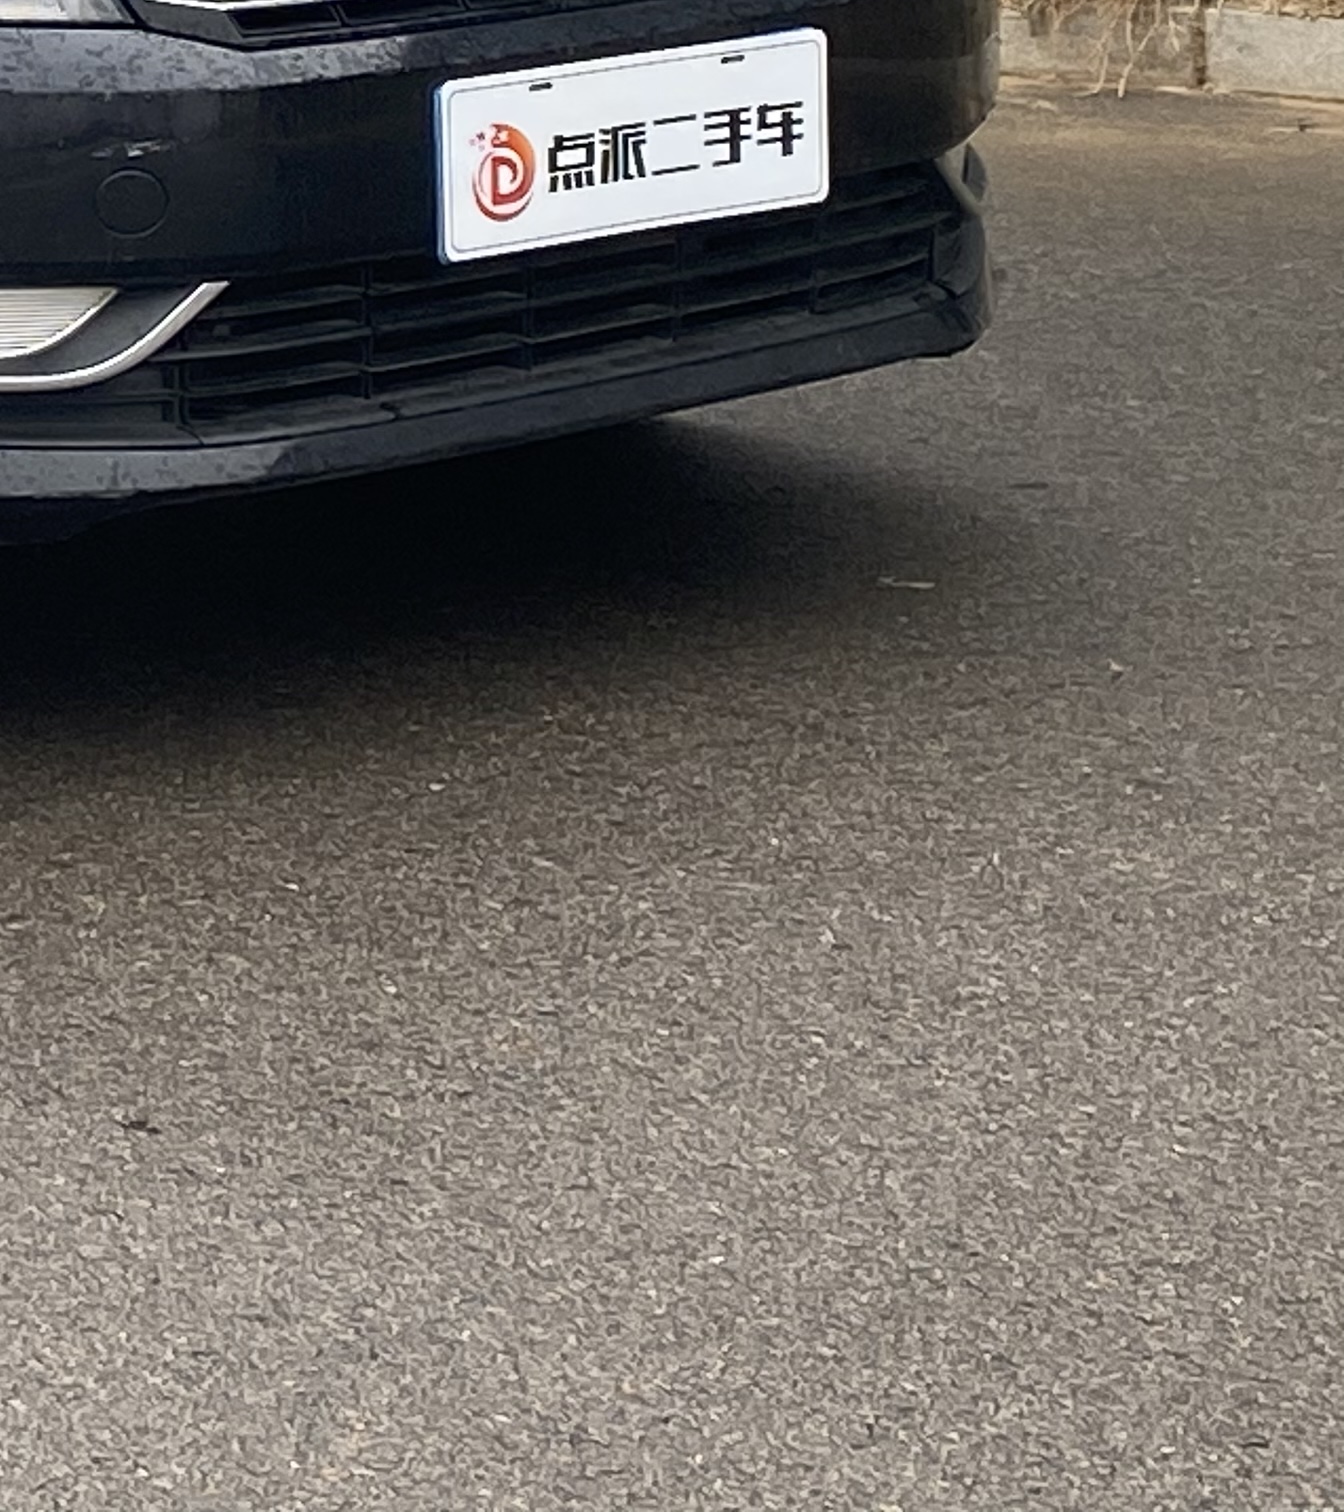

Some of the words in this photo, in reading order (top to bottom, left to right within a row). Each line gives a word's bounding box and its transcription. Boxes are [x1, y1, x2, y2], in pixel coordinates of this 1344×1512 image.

[547, 101, 804, 192] 点派二手车
